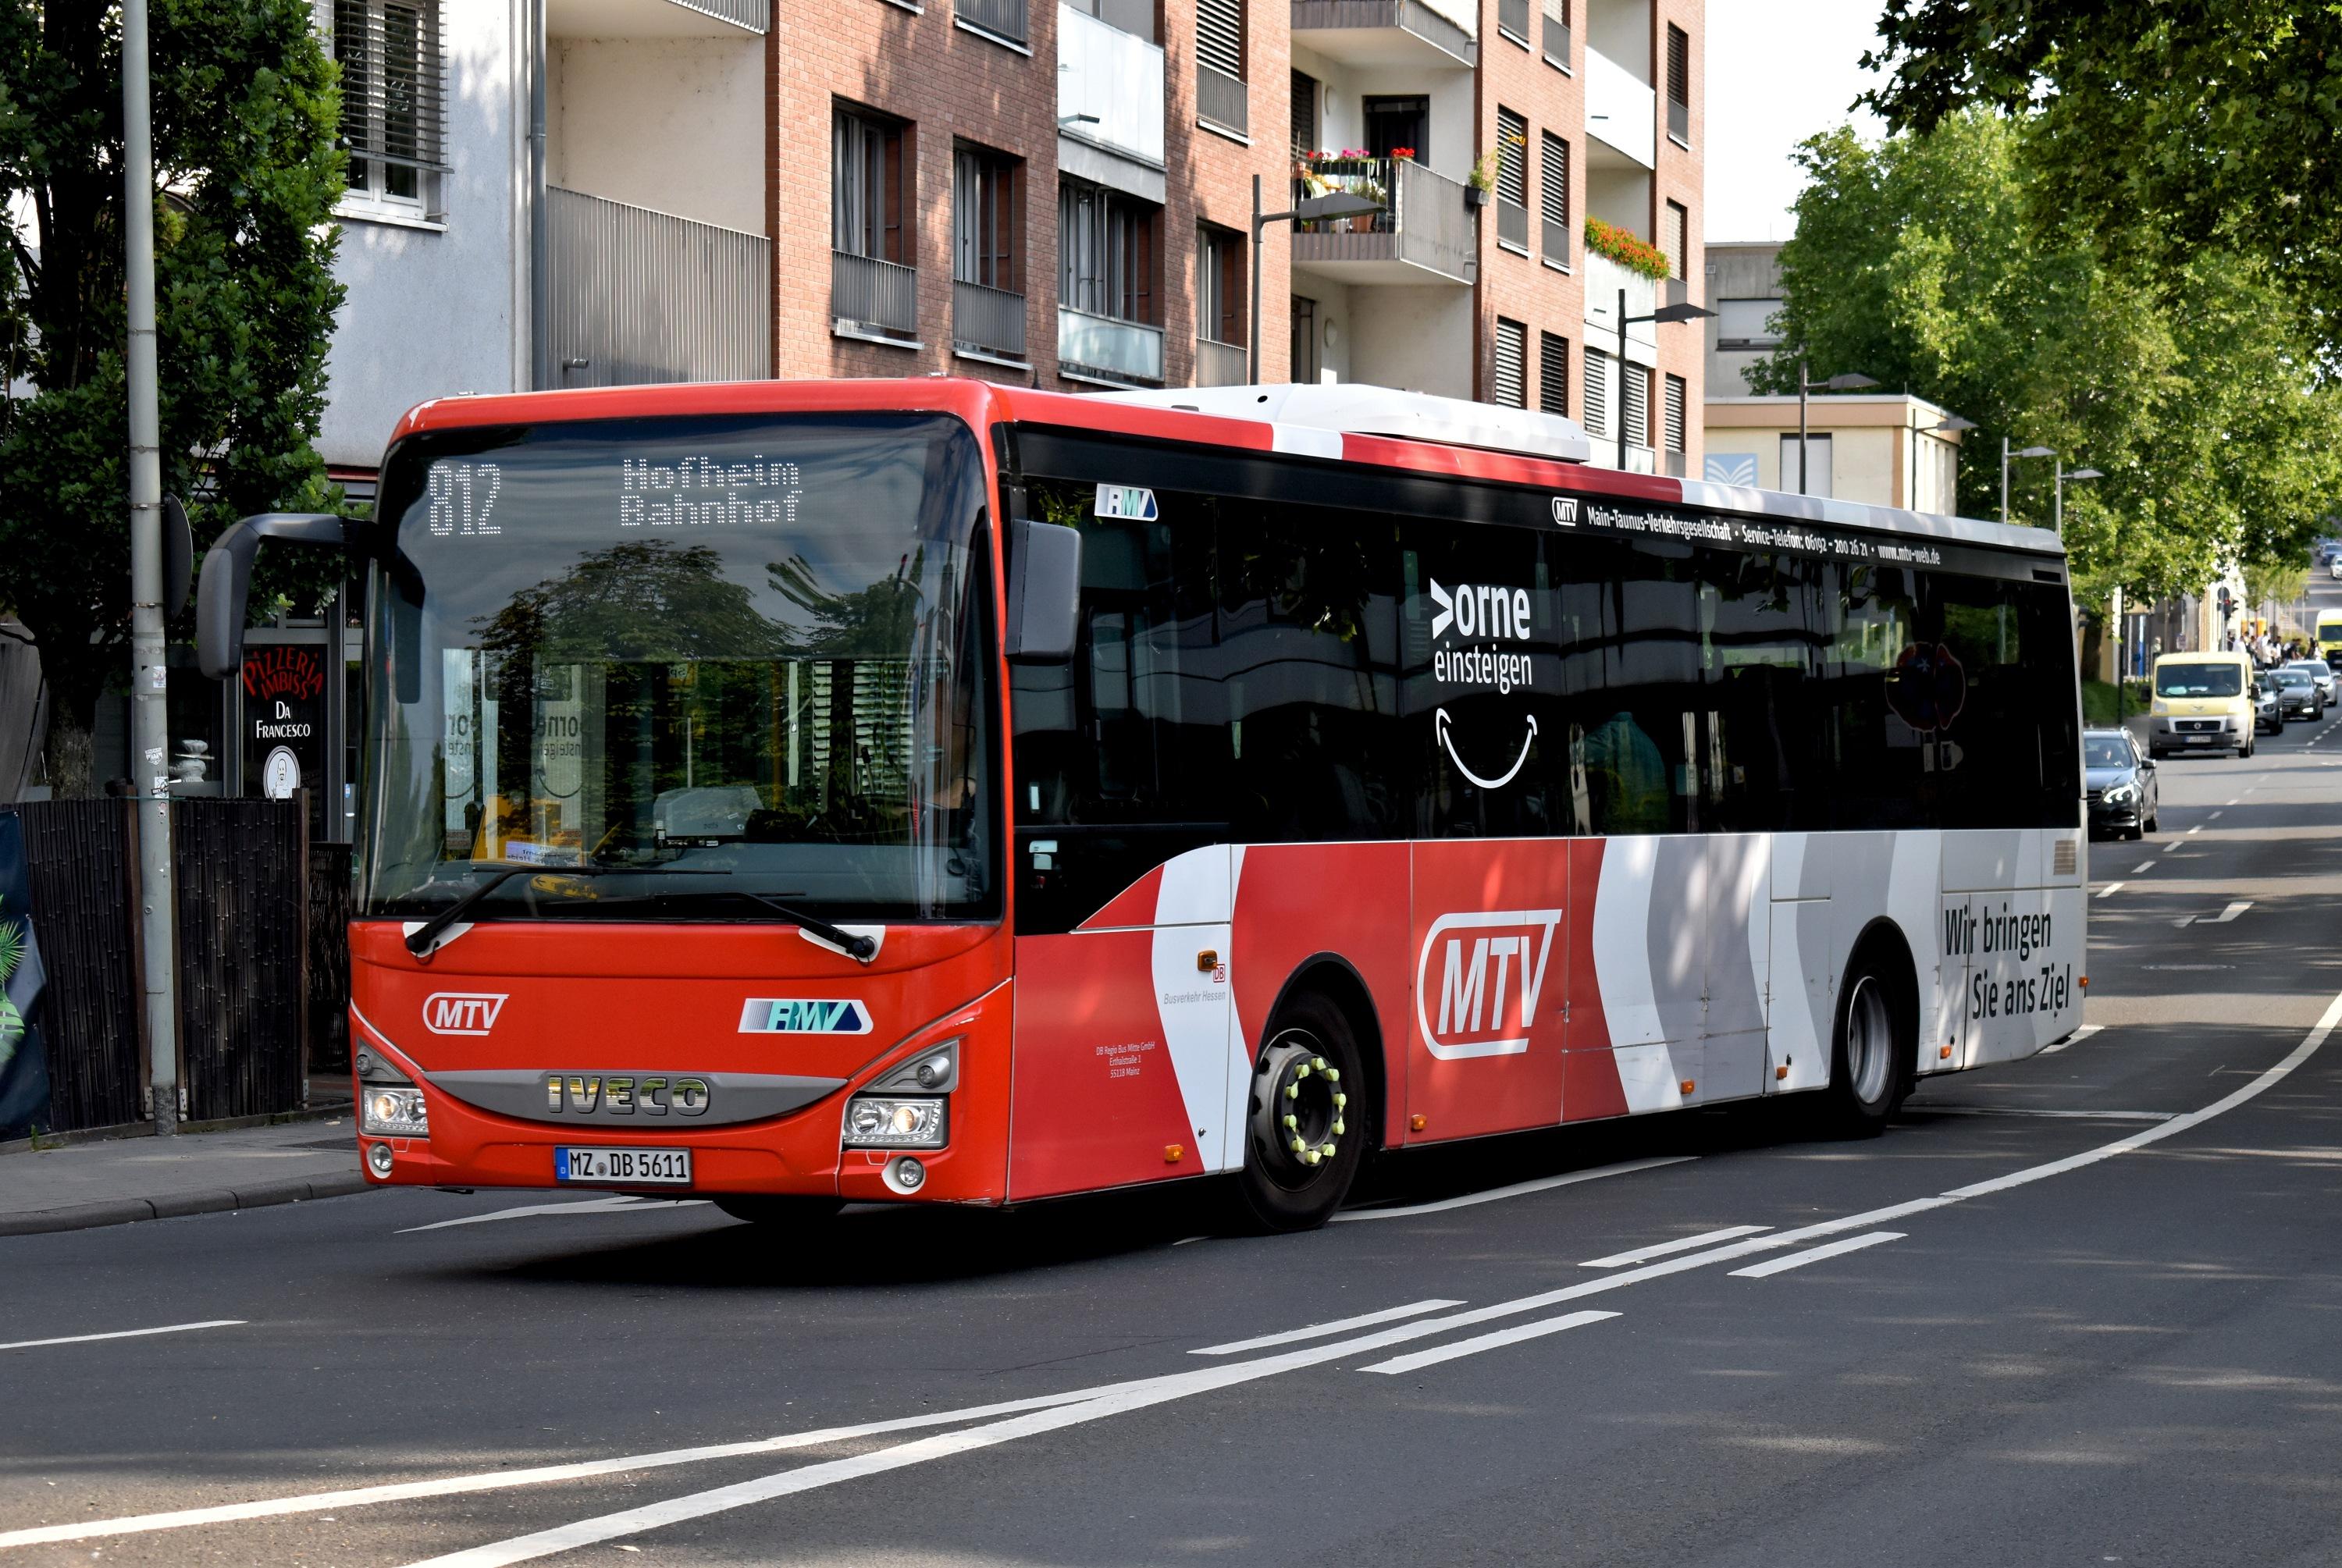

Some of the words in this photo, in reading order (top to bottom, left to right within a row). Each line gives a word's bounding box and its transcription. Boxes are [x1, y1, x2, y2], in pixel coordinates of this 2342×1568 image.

[623, 455, 799, 490] Hofheim
[428, 464, 501, 537] 812
[621, 490, 803, 526] Bahnhof
[1108, 487, 1151, 517] RMV
[1556, 502, 1577, 522] MTV
[1586, 506, 1732, 541] Main-Taunus-Verkehrsgesellschaft
[1742, 524, 1804, 549] Service-Telefon:
[1805, 537, 1827, 554] 06192
[1835, 539, 1849, 553] 200
[1849, 540, 1859, 556] 26
[1860, 544, 1868, 556] 21
[1878, 544, 1941, 565] www.mtv-web.de
[1434, 641, 1532, 695] einsteigen
[1945, 904, 1977, 955] Wir
[1983, 901, 2052, 962] bringen
[1437, 918, 1556, 1035] MTV
[1972, 969, 1999, 1019] Sie
[2004, 976, 2036, 1015] ans
[2039, 962, 2071, 1012] Ziel
[435, 997, 506, 1029] MTV
[1163, 992, 1201, 1005] Busverkehr
[1201, 990, 1226, 1002] Hessen
[767, 1001, 850, 1031] RMV
[1096, 1047, 1104, 1055] DB
[1104, 1047, 1118, 1056] Regio
[1118, 1045, 1127, 1054] Bus
[1141, 1041, 1155, 1051] GmbH
[1126, 1067, 1141, 1076] Mainz
[548, 1076, 710, 1116] IVECO
[570, 1152, 594, 1176] MZ
[610, 1153, 634, 1177] DB
[639, 1154, 687, 1179] 5611
